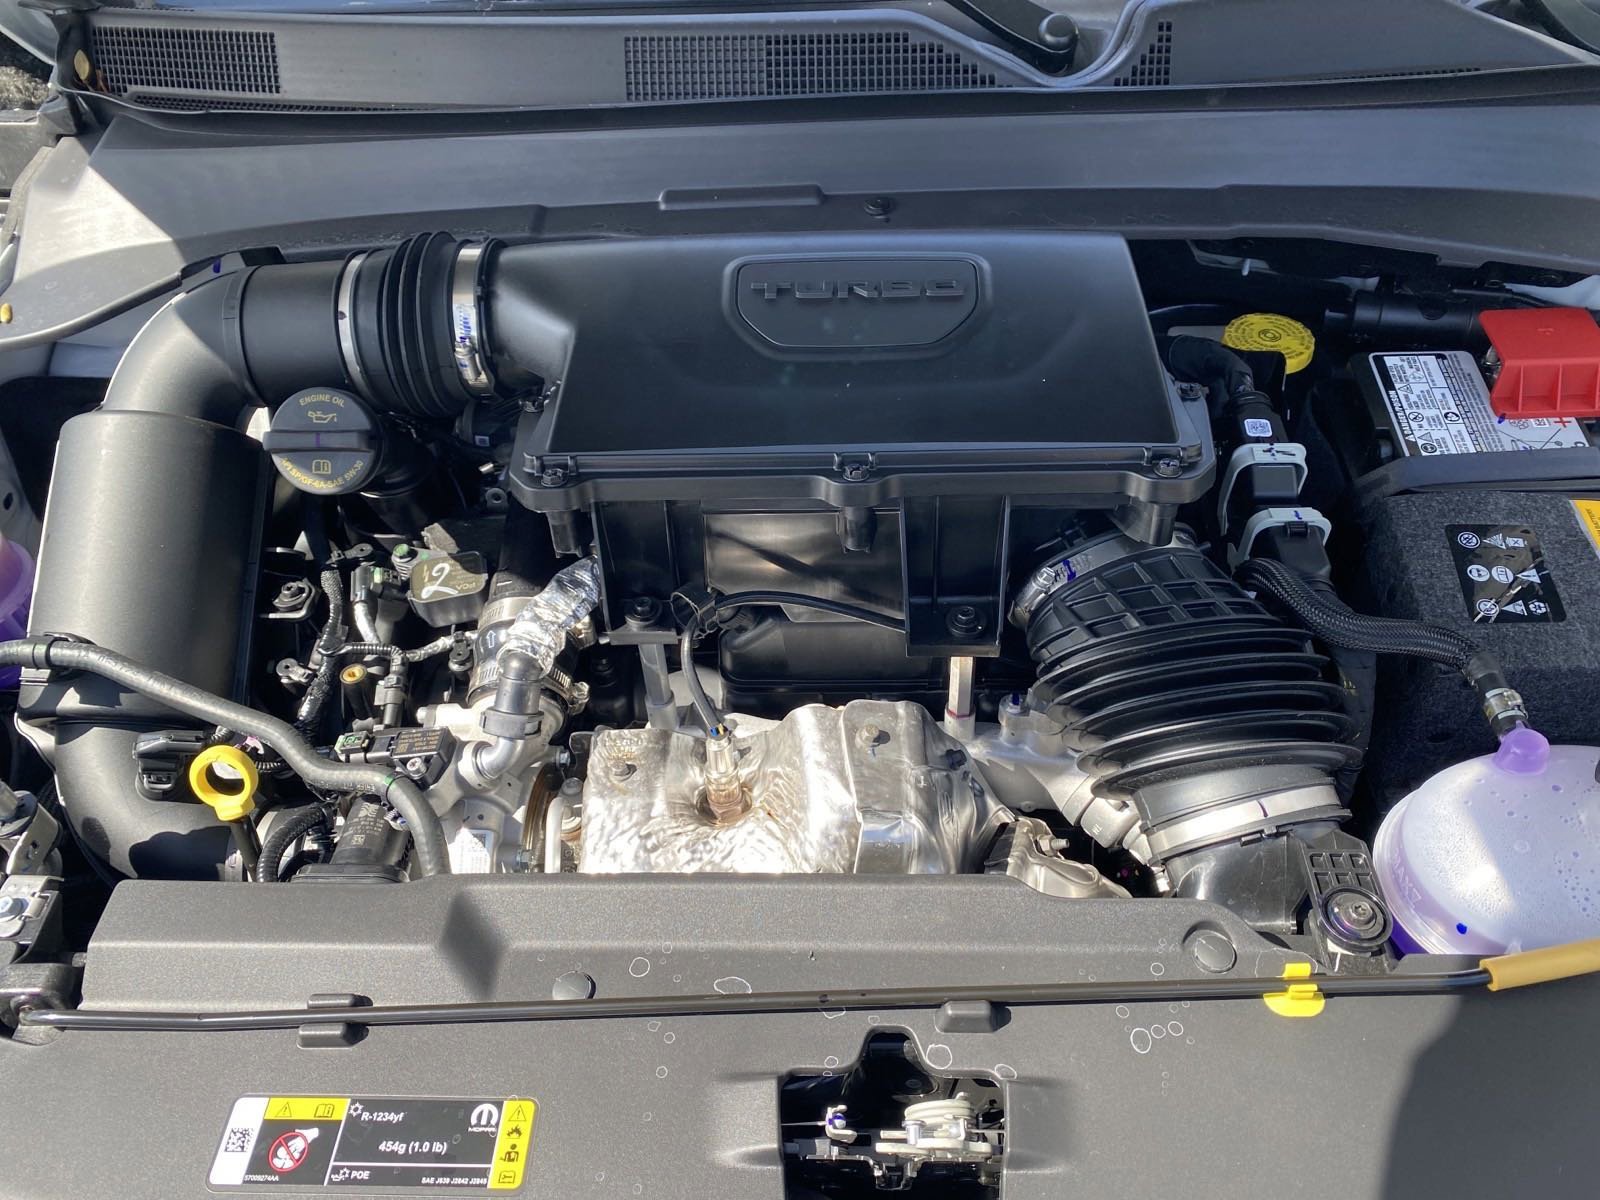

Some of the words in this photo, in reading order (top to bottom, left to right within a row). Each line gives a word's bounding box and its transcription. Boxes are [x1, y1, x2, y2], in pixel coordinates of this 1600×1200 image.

[751, 280, 965, 299] TURBO
[299, 393, 331, 406] ENGINE
[331, 396, 345, 408] OIL
[343, 460, 364, 481] 5W-30
[421, 562, 459, 599] 2
[360, 1111, 404, 1122] R-1234yf
[378, 1141, 407, 1155] 454g
[407, 1141, 431, 1154] (1.0
[431, 1141, 448, 1155] lb)
[350, 1170, 371, 1180] POE
[421, 1176, 436, 1184] SAE
